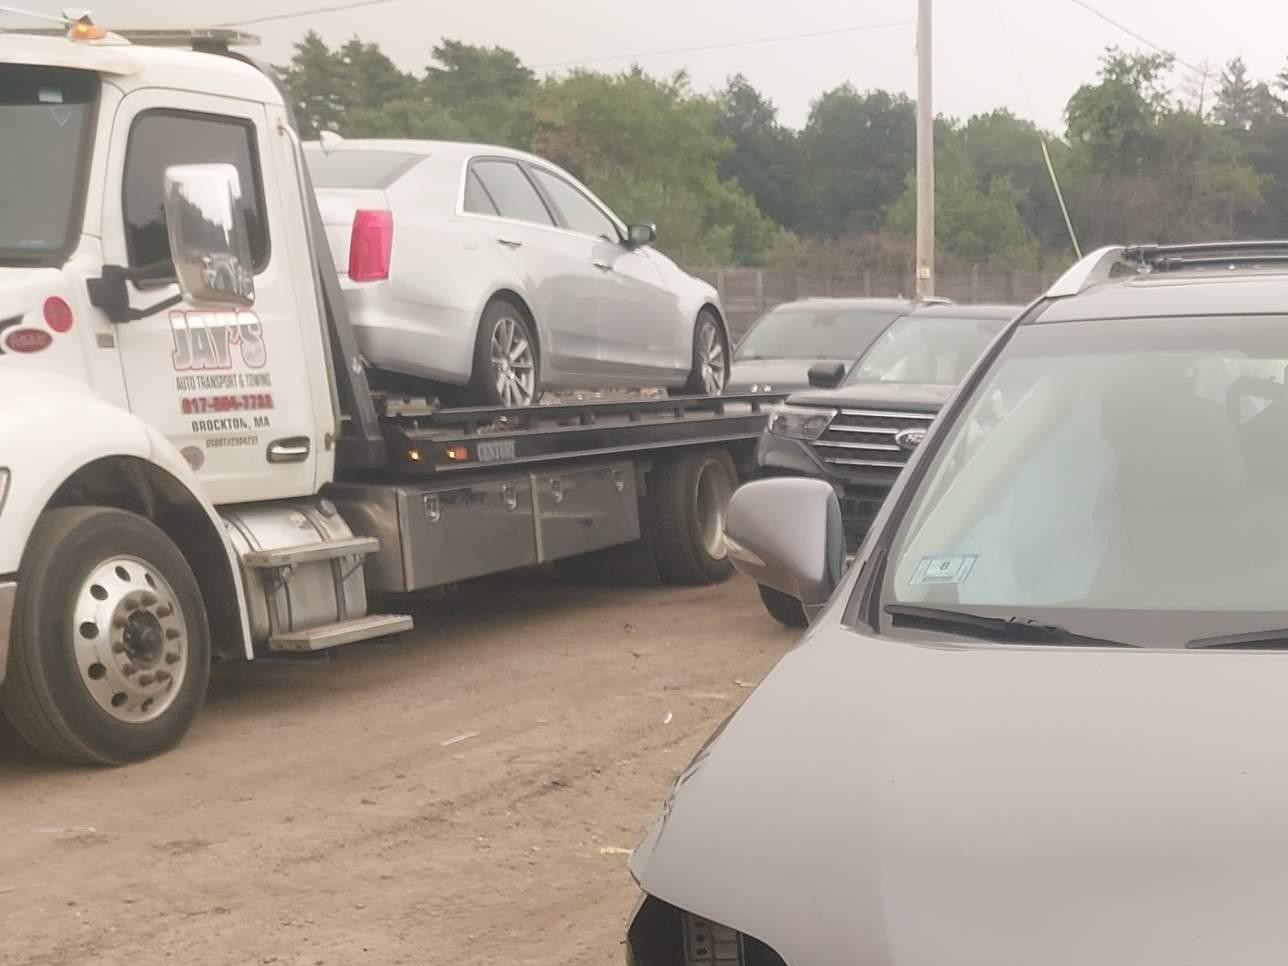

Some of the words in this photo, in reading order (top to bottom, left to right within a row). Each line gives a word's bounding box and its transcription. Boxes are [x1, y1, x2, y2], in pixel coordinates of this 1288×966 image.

[168, 309, 267, 371] JAY'S
[176, 375, 196, 391] AUTO
[197, 374, 238, 390] TRANSPORT
[245, 373, 272, 388] TOWING
[253, 416, 271, 428] MA
